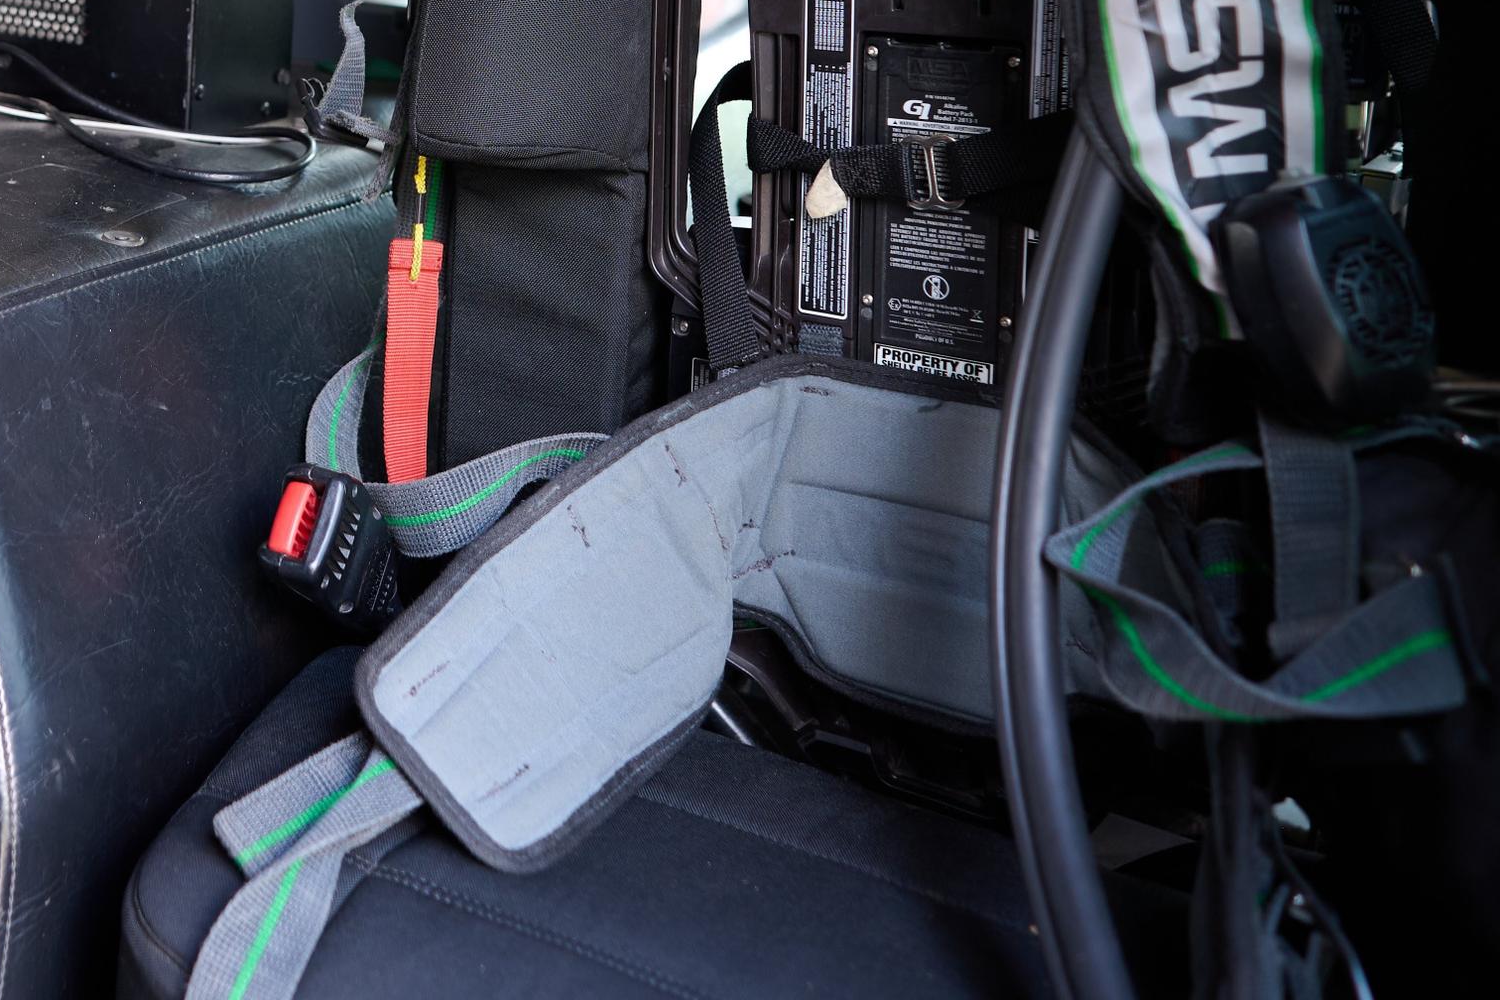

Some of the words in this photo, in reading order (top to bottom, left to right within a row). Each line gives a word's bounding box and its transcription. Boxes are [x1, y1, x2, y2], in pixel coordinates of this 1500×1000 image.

[902, 100, 931, 120] G1
[882, 348, 960, 372] PROPERTY
[964, 363, 983, 377] OF
